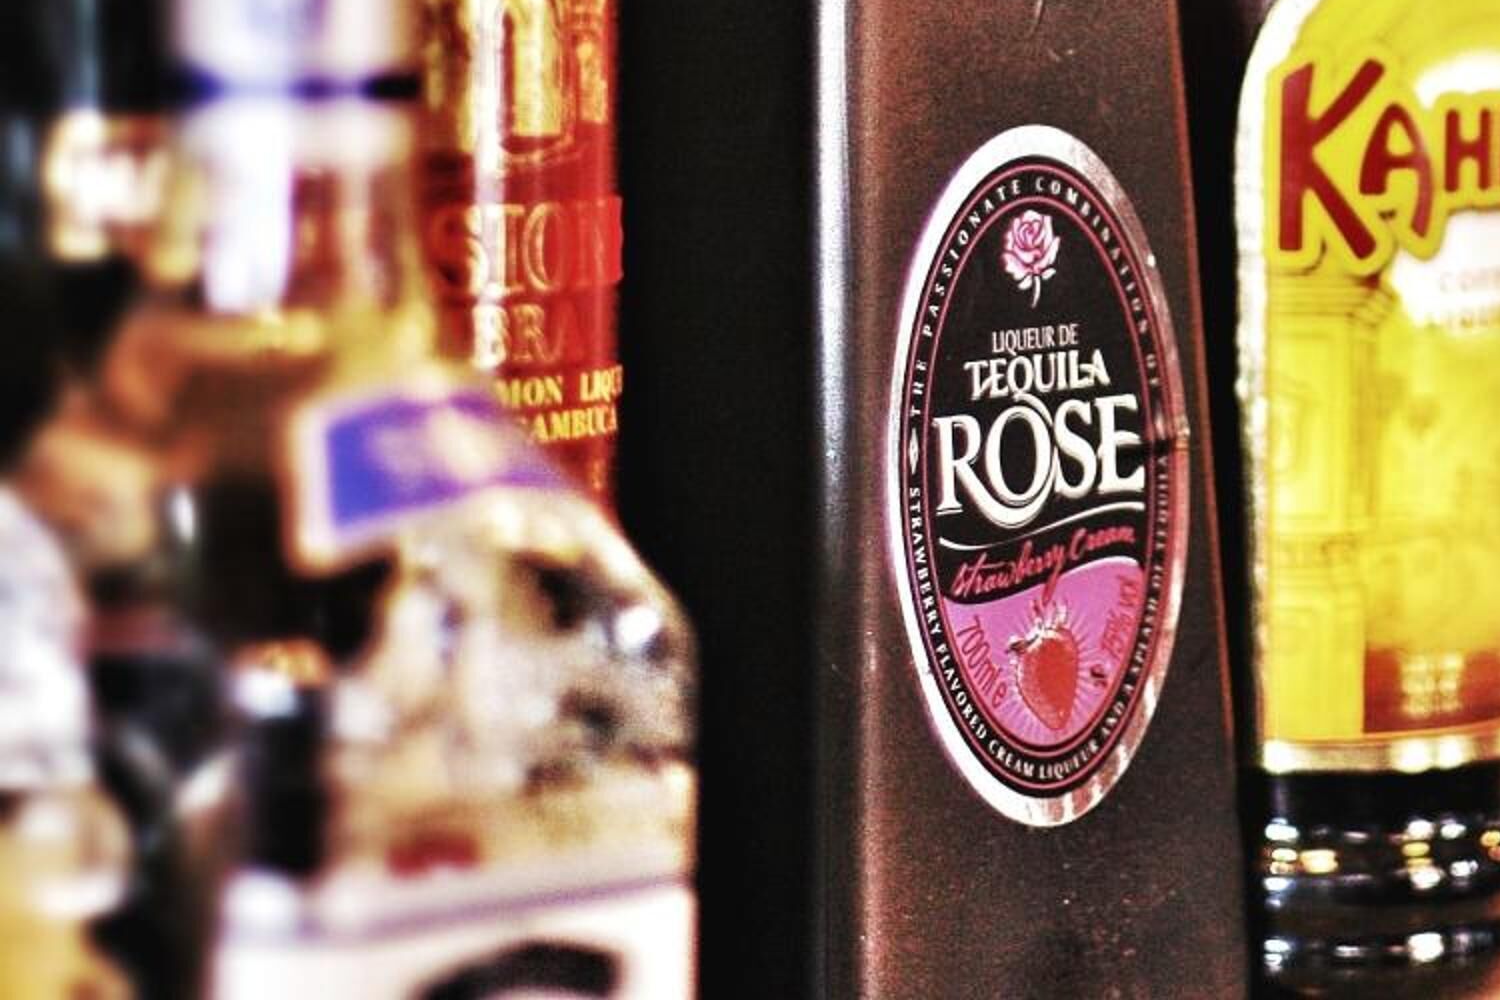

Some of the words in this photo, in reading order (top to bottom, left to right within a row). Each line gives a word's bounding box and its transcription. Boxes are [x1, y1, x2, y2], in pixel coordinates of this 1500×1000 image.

[911, 359, 927, 416] THE
[922, 179, 1021, 337] PASSIONATE
[992, 325, 1055, 356] LIQUEUR
[1058, 323, 1079, 345] DE
[493, 373, 564, 409] MON
[963, 348, 1111, 401] TEQUILA
[528, 403, 619, 443] AMBUCA
[932, 393, 1145, 529] ROSE
[952, 540, 1066, 606] Strawberry
[908, 487, 942, 635] STRAWBERRY
[936, 643, 988, 740] FLAVORED
[988, 738, 1034, 778] CREAM
[1038, 739, 1100, 780] LIQUEUR
[1100, 701, 1126, 737] AND
